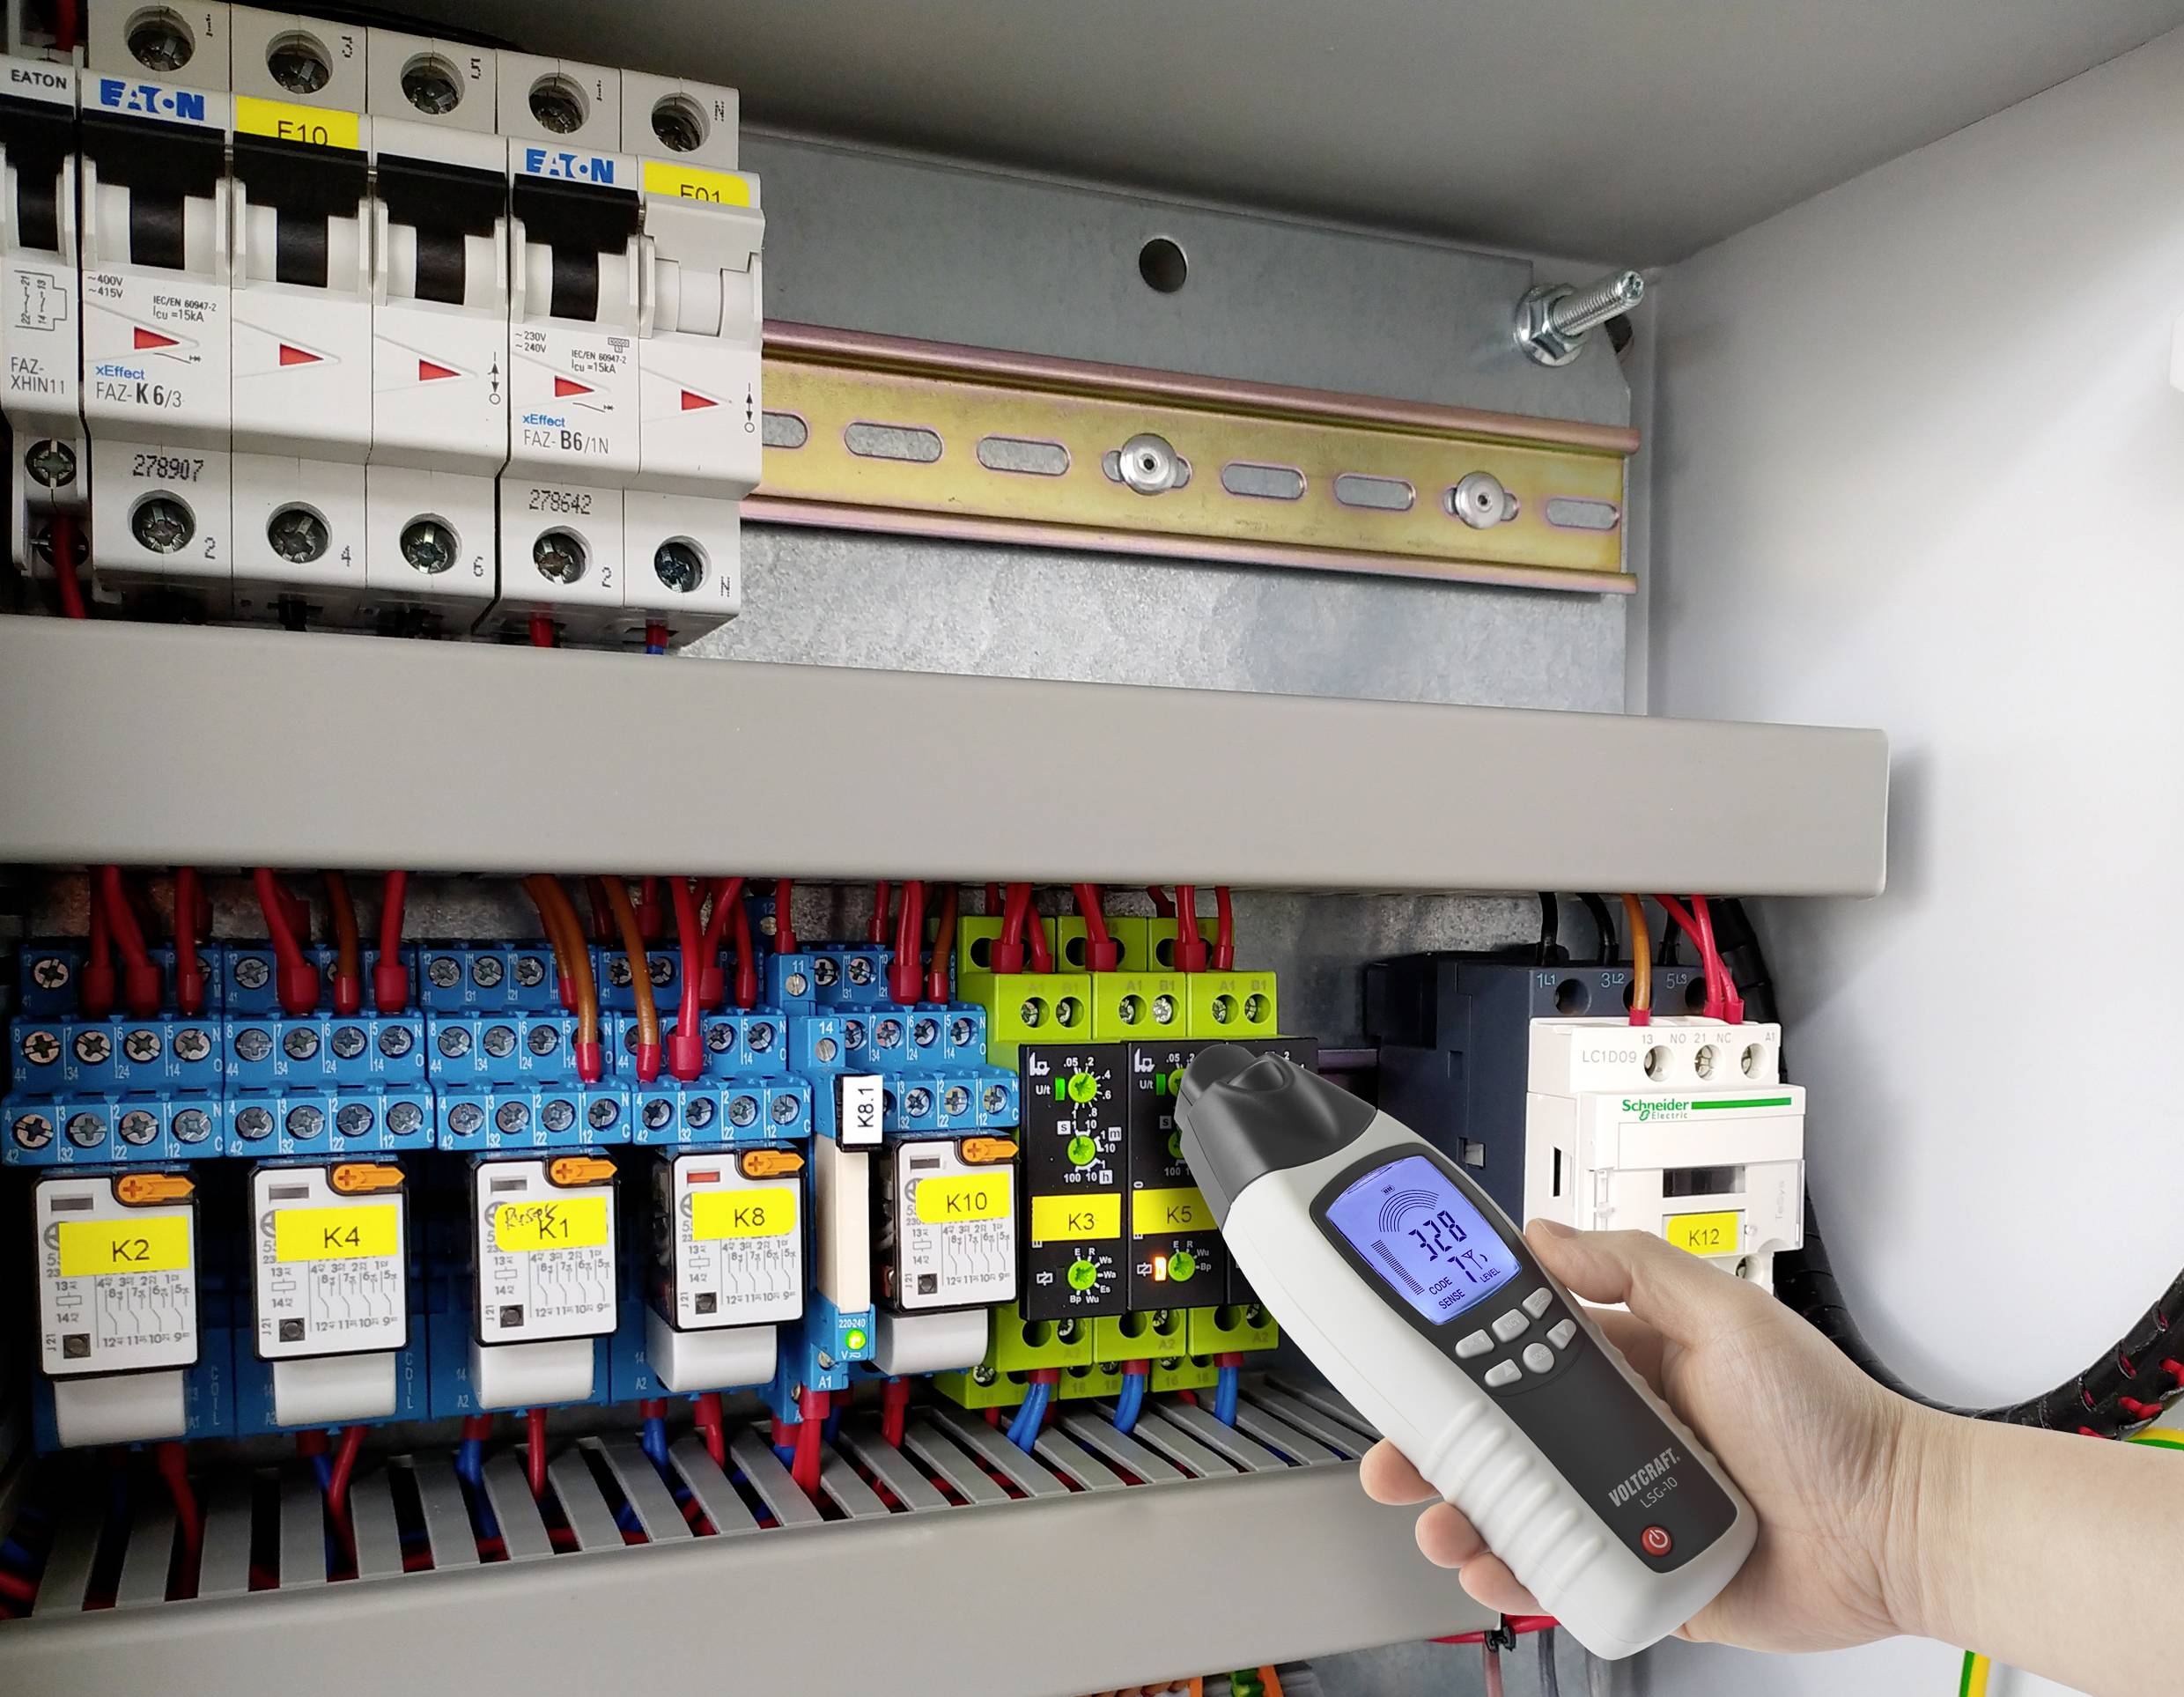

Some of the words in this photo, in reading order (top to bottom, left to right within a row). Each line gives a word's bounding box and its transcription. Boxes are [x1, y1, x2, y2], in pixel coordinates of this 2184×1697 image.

[11, 69, 68, 90] EATON
[100, 78, 205, 122] EATON
[525, 148, 615, 185] EATON
[153, 295, 181, 307] IEC/EN
[184, 299, 217, 312] 60947-2
[572, 349, 596, 361] IEC/EN
[598, 351, 627, 365] 60947-2
[95, 364, 145, 380] xEffect
[11, 374, 64, 395] XHIN11
[522, 413, 565, 428] xEffect
[132, 454, 204, 483] 278907
[528, 489, 593, 515] 278642
[792, 960, 805, 973] 11
[430, 1022, 437, 1037] 8
[476, 1022, 483, 1036] 7
[521, 1021, 528, 1034] 6
[742, 1018, 749, 1031] 5
[819, 1021, 833, 1034] 14
[1641, 1033, 1654, 1045] 13
[1670, 1032, 1687, 1044] NO
[1694, 1032, 1707, 1044] 21
[1716, 1032, 1731, 1044] NC
[1765, 1031, 1775, 1043] A1
[521, 1057, 533, 1070] 24
[1582, 1049, 1638, 1064] LC1D09
[430, 1059, 441, 1073] 44
[477, 1058, 488, 1071] 34
[1036, 1084, 1051, 1096] U/t
[1140, 1079, 1154, 1090] U/t
[488, 1095, 495, 1110] 3
[535, 1094, 542, 1108] 2
[637, 1092, 643, 1106] 4
[681, 1091, 686, 1105] 3
[723, 1089, 729, 1103] 2
[439, 1096, 446, 1111] 4
[856, 1087, 874, 1129] K8.1
[1622, 1097, 1690, 1113] Schneider
[1651, 1110, 1688, 1120] Electric
[766, 1125, 777, 1138] 12
[1085, 1119, 1097, 1130] 10
[489, 1133, 501, 1147] 32
[535, 1132, 548, 1146] 22
[582, 1130, 594, 1144] 12
[637, 1130, 648, 1142] 42
[681, 1127, 691, 1141] 32
[724, 1126, 734, 1140] 22
[442, 1134, 454, 1150] 42
[1104, 1143, 1116, 1154] 10
[1063, 1172, 1081, 1183] 100
[1085, 1171, 1097, 1182] 10
[946, 1192, 987, 1214] K10
[734, 1206, 765, 1228] K8
[1068, 1212, 1096, 1231] K3
[1167, 1206, 1192, 1225] K5
[538, 1215, 568, 1240] K1
[323, 1225, 361, 1249] K4
[1408, 1210, 1468, 1262] 328
[1688, 1228, 1720, 1247] K12
[112, 1238, 151, 1263] K2
[1479, 1267, 1501, 1283] LEVEL
[1428, 1276, 1453, 1295] CODE
[1438, 1288, 1465, 1310] SENSE
[838, 1318, 867, 1329] 220-240
[817, 1376, 832, 1390] A1
[458, 1395, 469, 1408] A2
[1640, 1477, 1678, 1509] LSG-10
